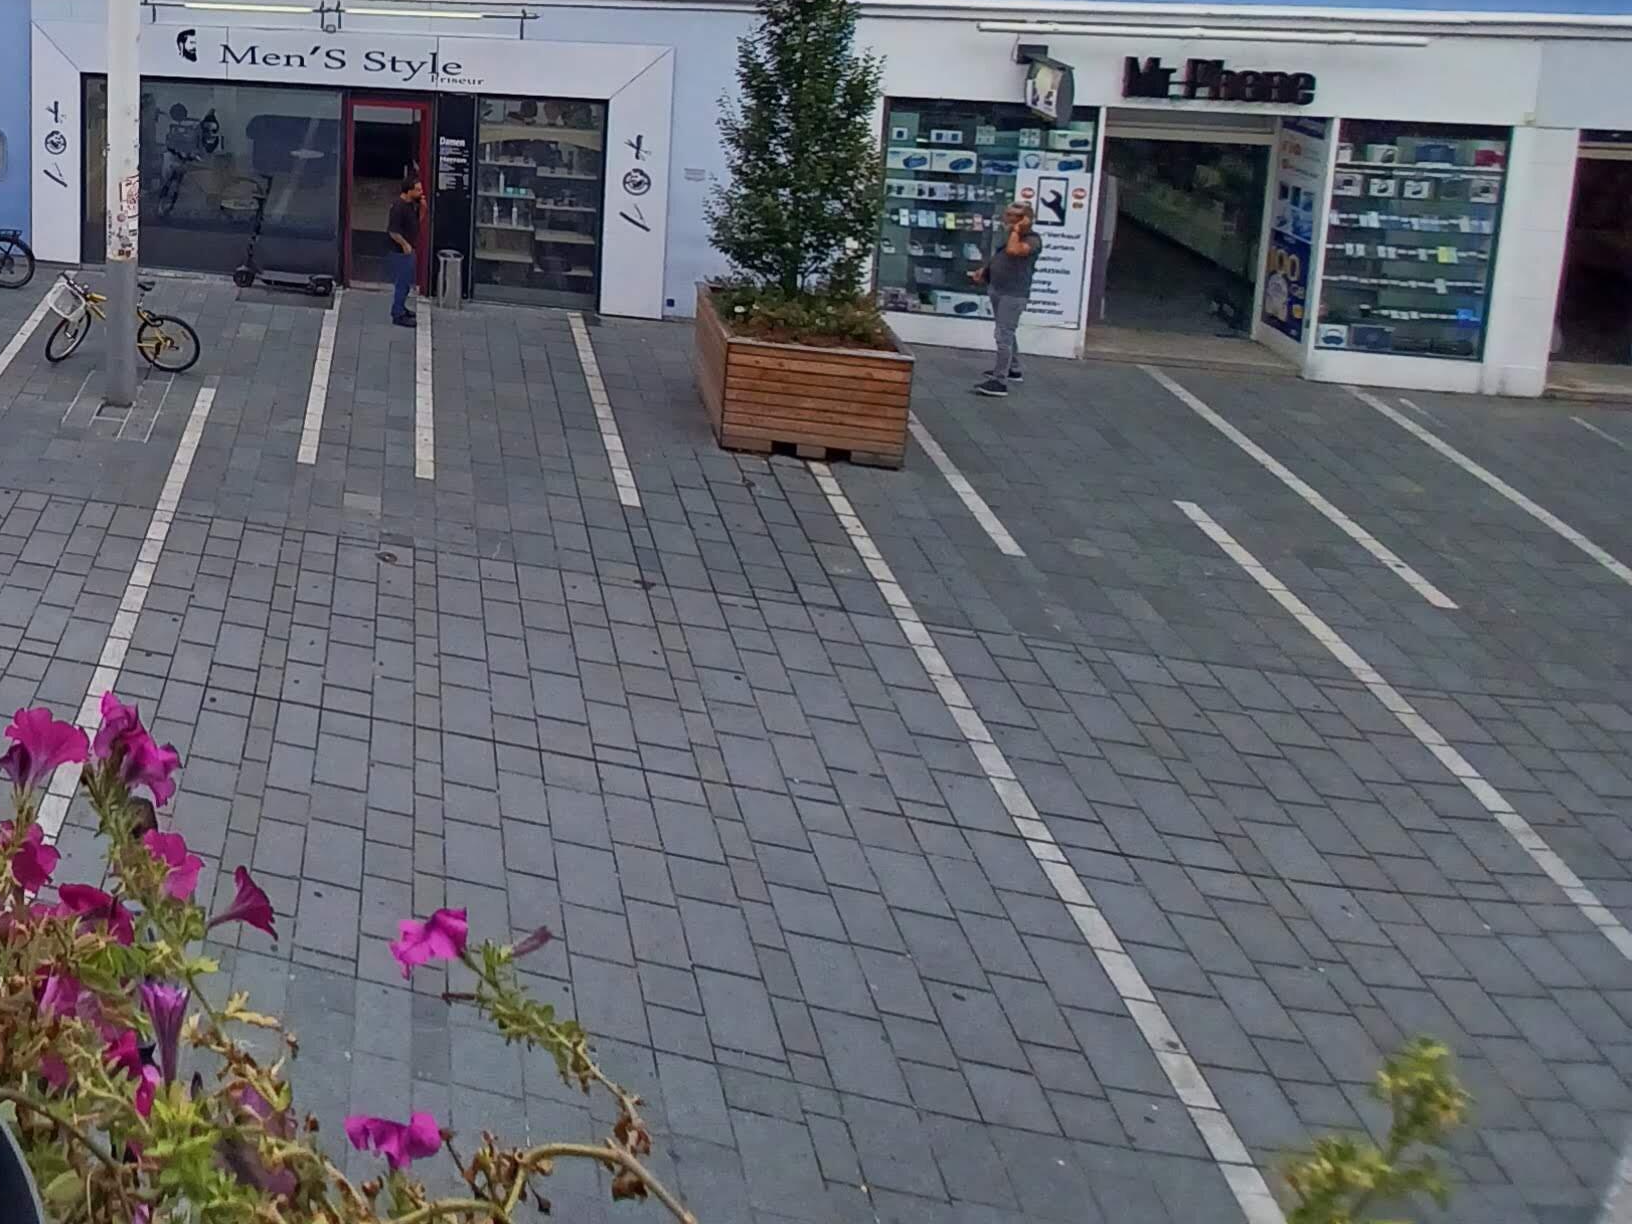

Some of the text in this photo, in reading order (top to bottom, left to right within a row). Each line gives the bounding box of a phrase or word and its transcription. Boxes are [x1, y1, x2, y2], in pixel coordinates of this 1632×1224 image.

[363, 50, 463, 82] Style
[431, 73, 485, 86] Friseur
[1182, 58, 1317, 105] Phone
[439, 136, 466, 147] Damen
